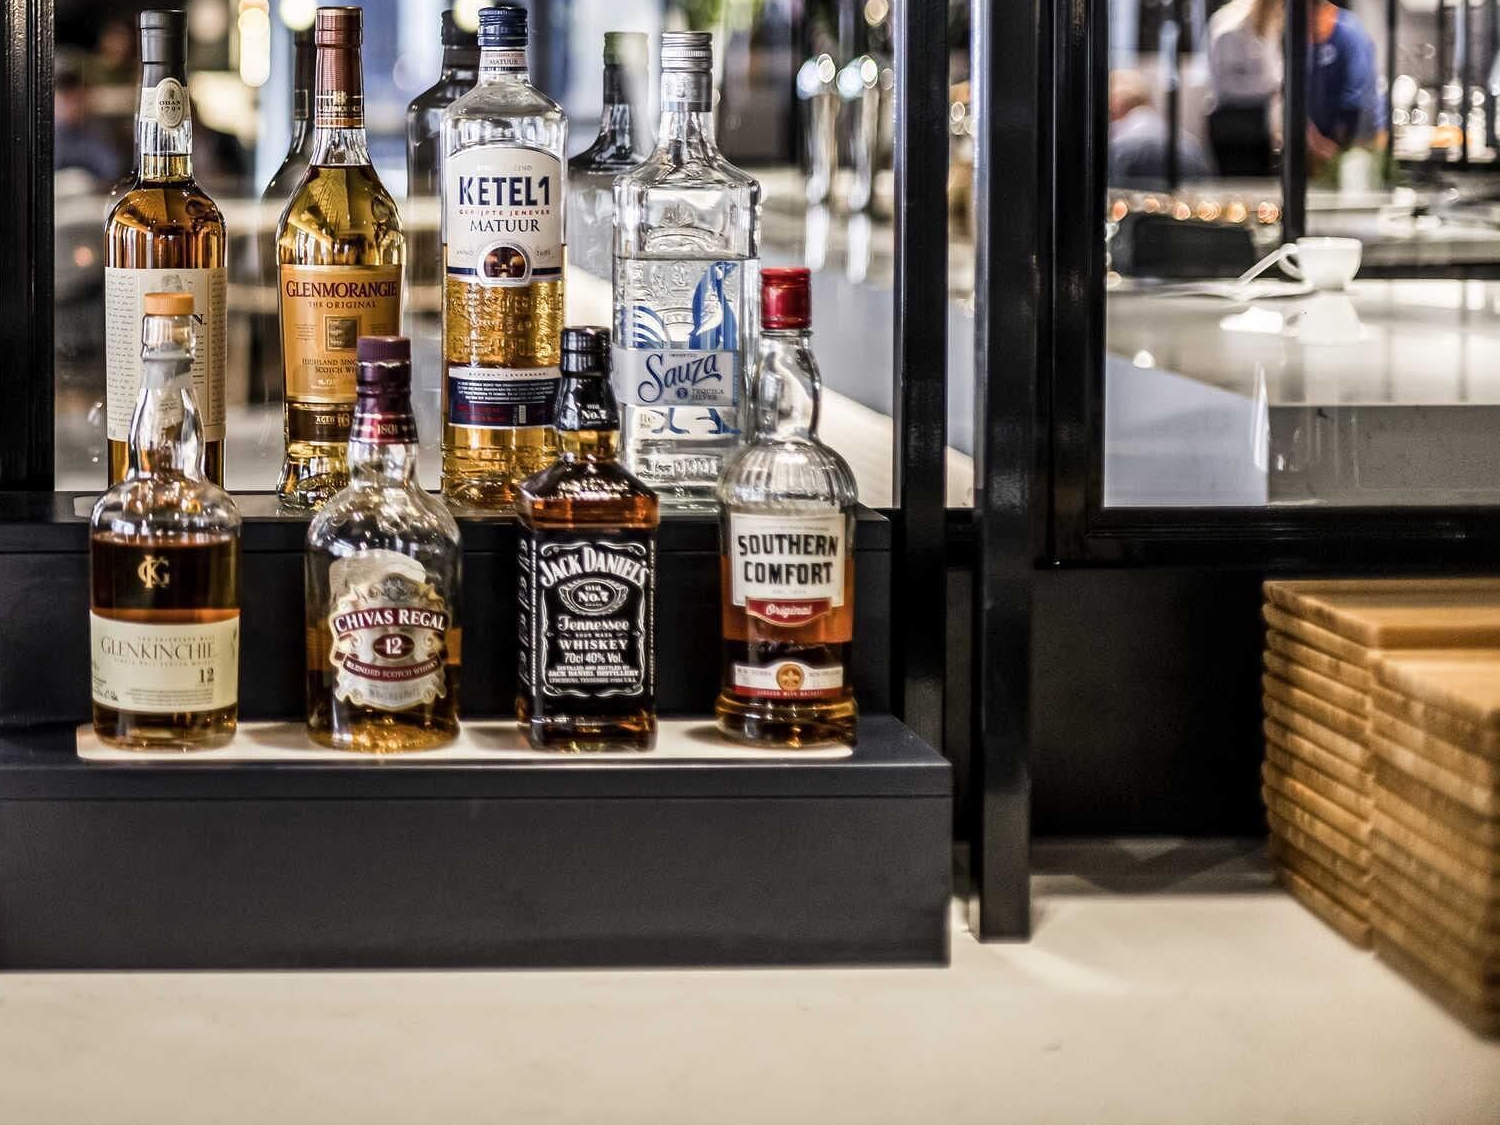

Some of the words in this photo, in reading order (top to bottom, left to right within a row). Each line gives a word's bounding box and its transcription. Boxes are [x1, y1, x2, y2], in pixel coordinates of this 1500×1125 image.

[470, 219, 541, 232] MATUUR
[286, 280, 398, 298] GLENMORANGIE
[327, 300, 377, 309] ORIGINAL
[638, 353, 722, 404] Sauza
[738, 534, 839, 557] SOUTHERN
[539, 552, 583, 588] JACK
[583, 546, 650, 587] DANIEL'S
[743, 561, 833, 585] COMFORT
[765, 603, 813, 619] Original
[335, 610, 394, 632] CHIVAS
[398, 609, 445, 631] REGAL
[557, 615, 630, 631] Tennessee
[386, 637, 402, 655] 12
[559, 640, 628, 650] WHISKEY
[564, 653, 583, 663] 70cl
[585, 653, 605, 663] 40%
[199, 667, 214, 683] 12
